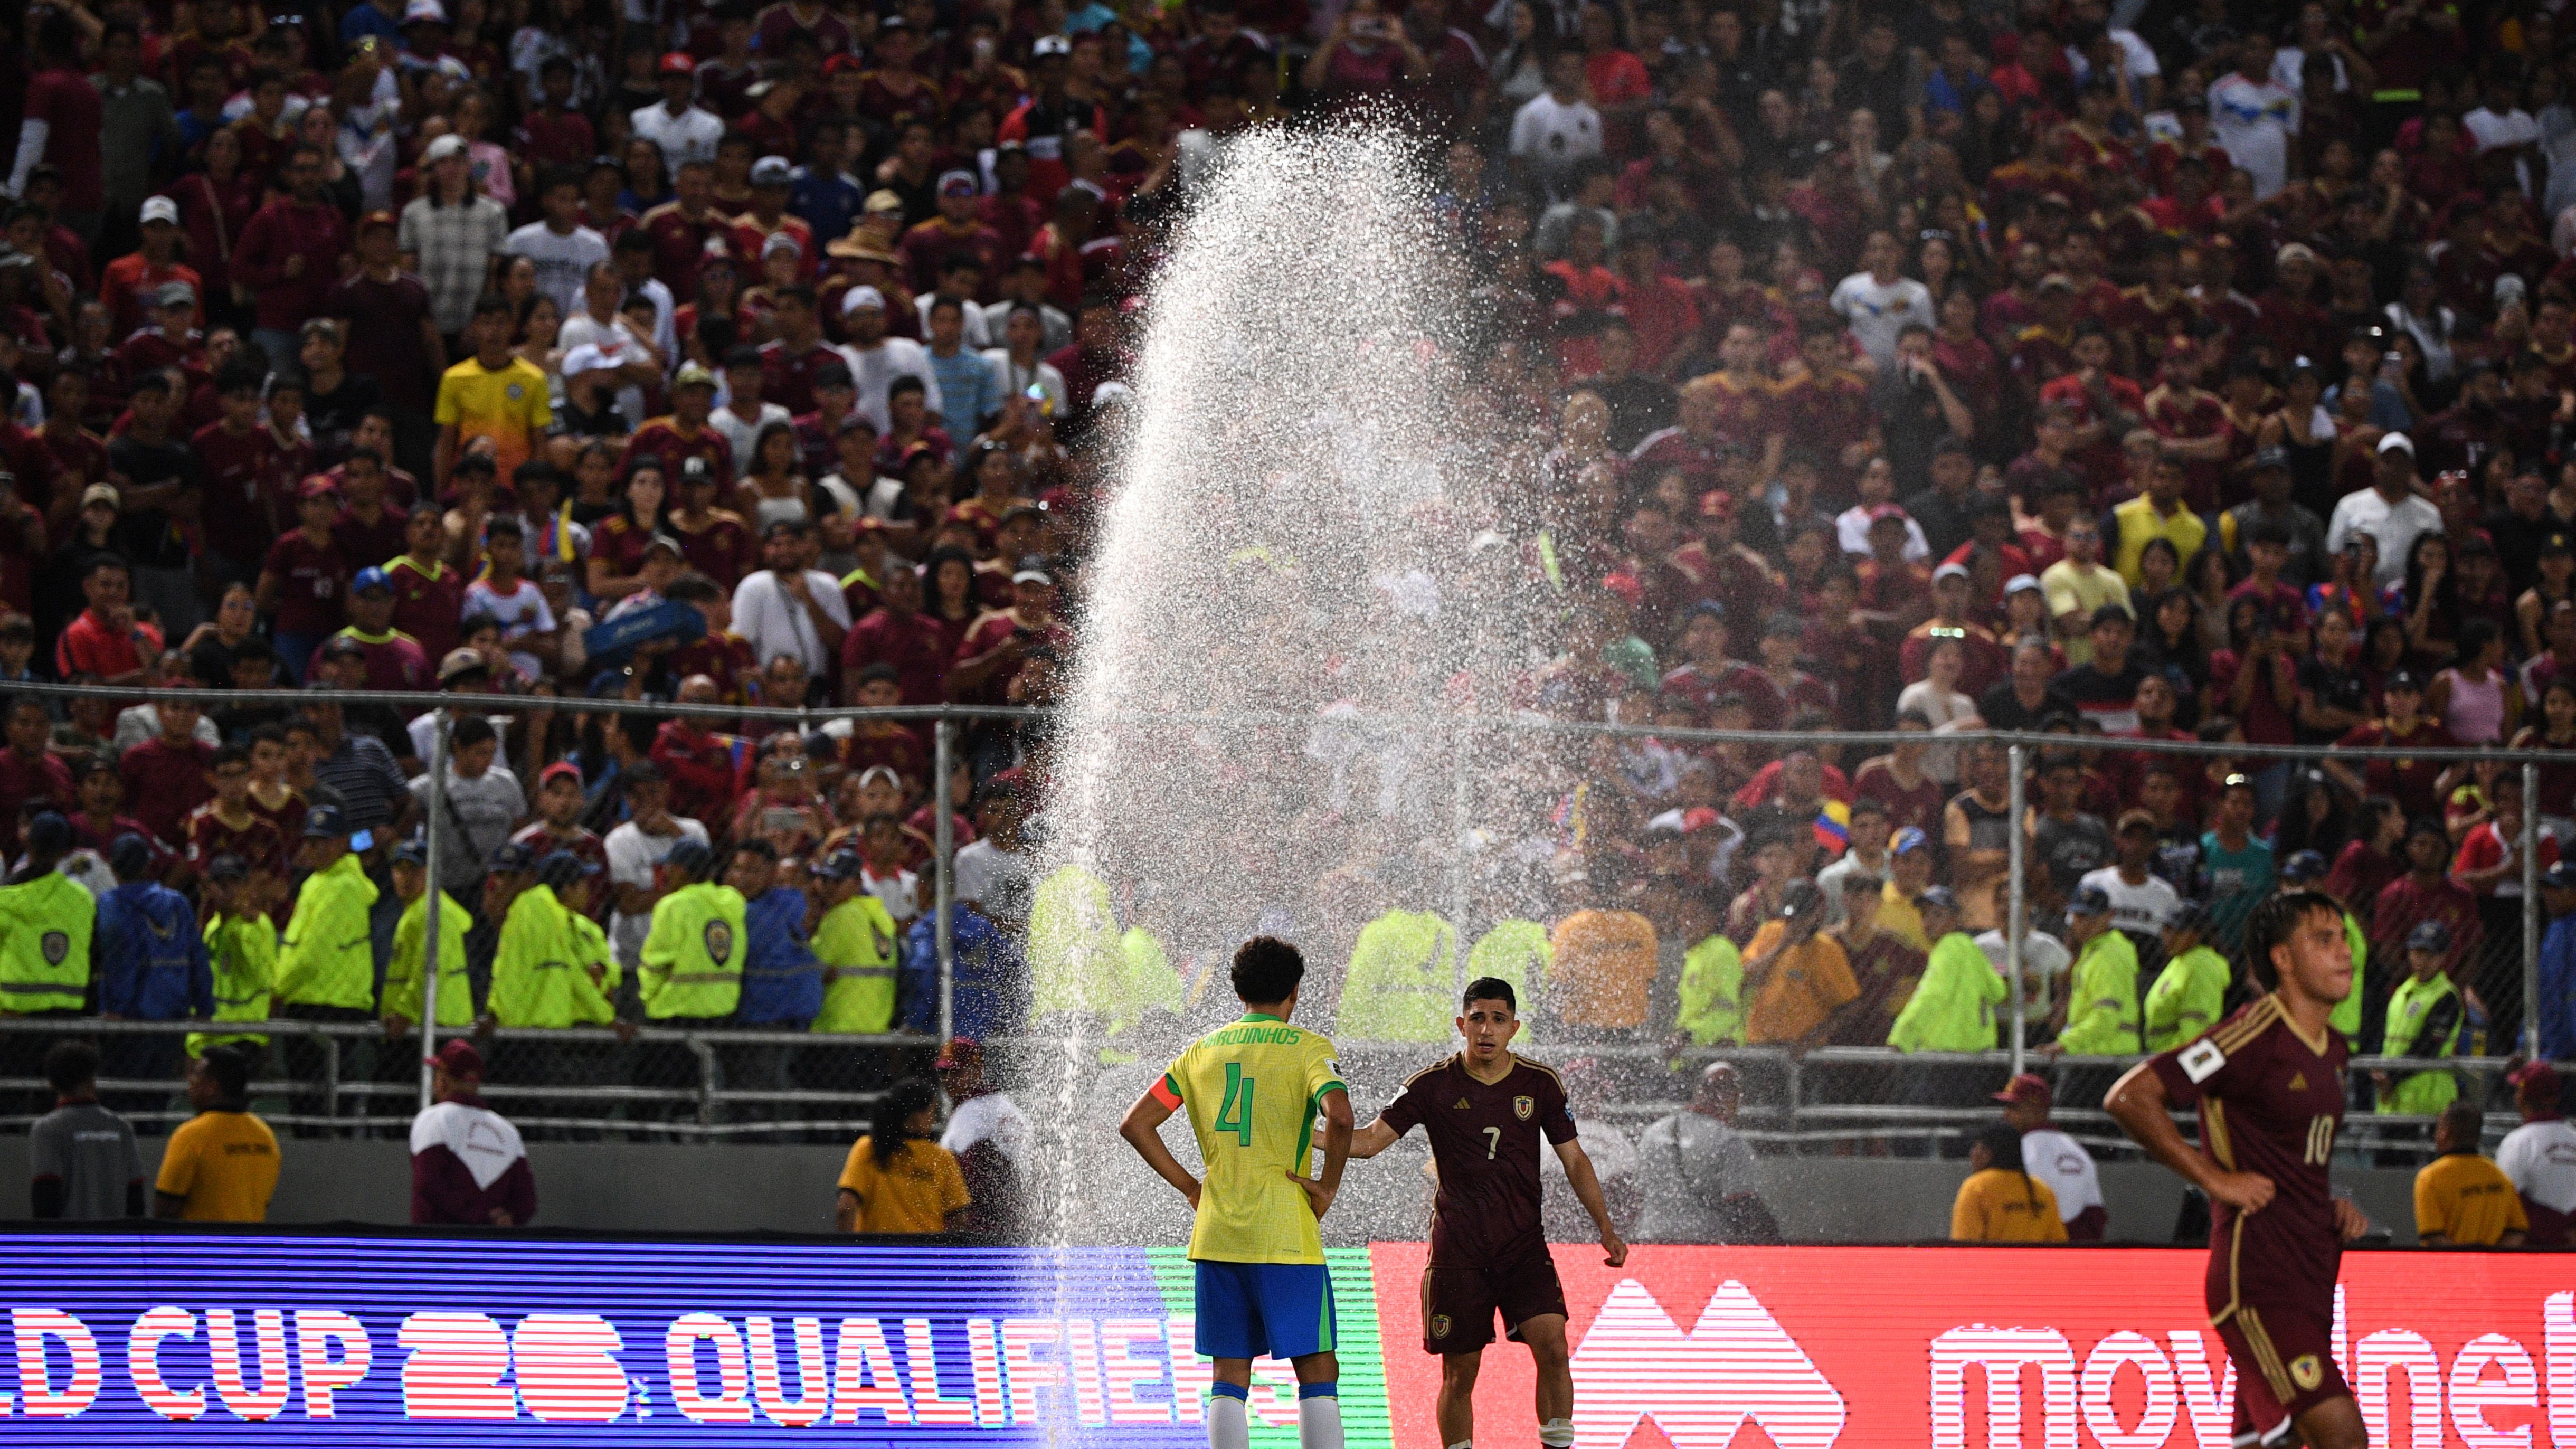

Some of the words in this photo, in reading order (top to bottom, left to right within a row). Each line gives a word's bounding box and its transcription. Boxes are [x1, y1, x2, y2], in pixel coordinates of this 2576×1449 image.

[1215, 1062, 1254, 1147] 4
[1482, 1126, 1501, 1160] 7
[2304, 1114, 2335, 1166] 10
[0, 1308, 102, 1419] D
[127, 1305, 372, 1421] CUP
[397, 1311, 630, 1422] 26
